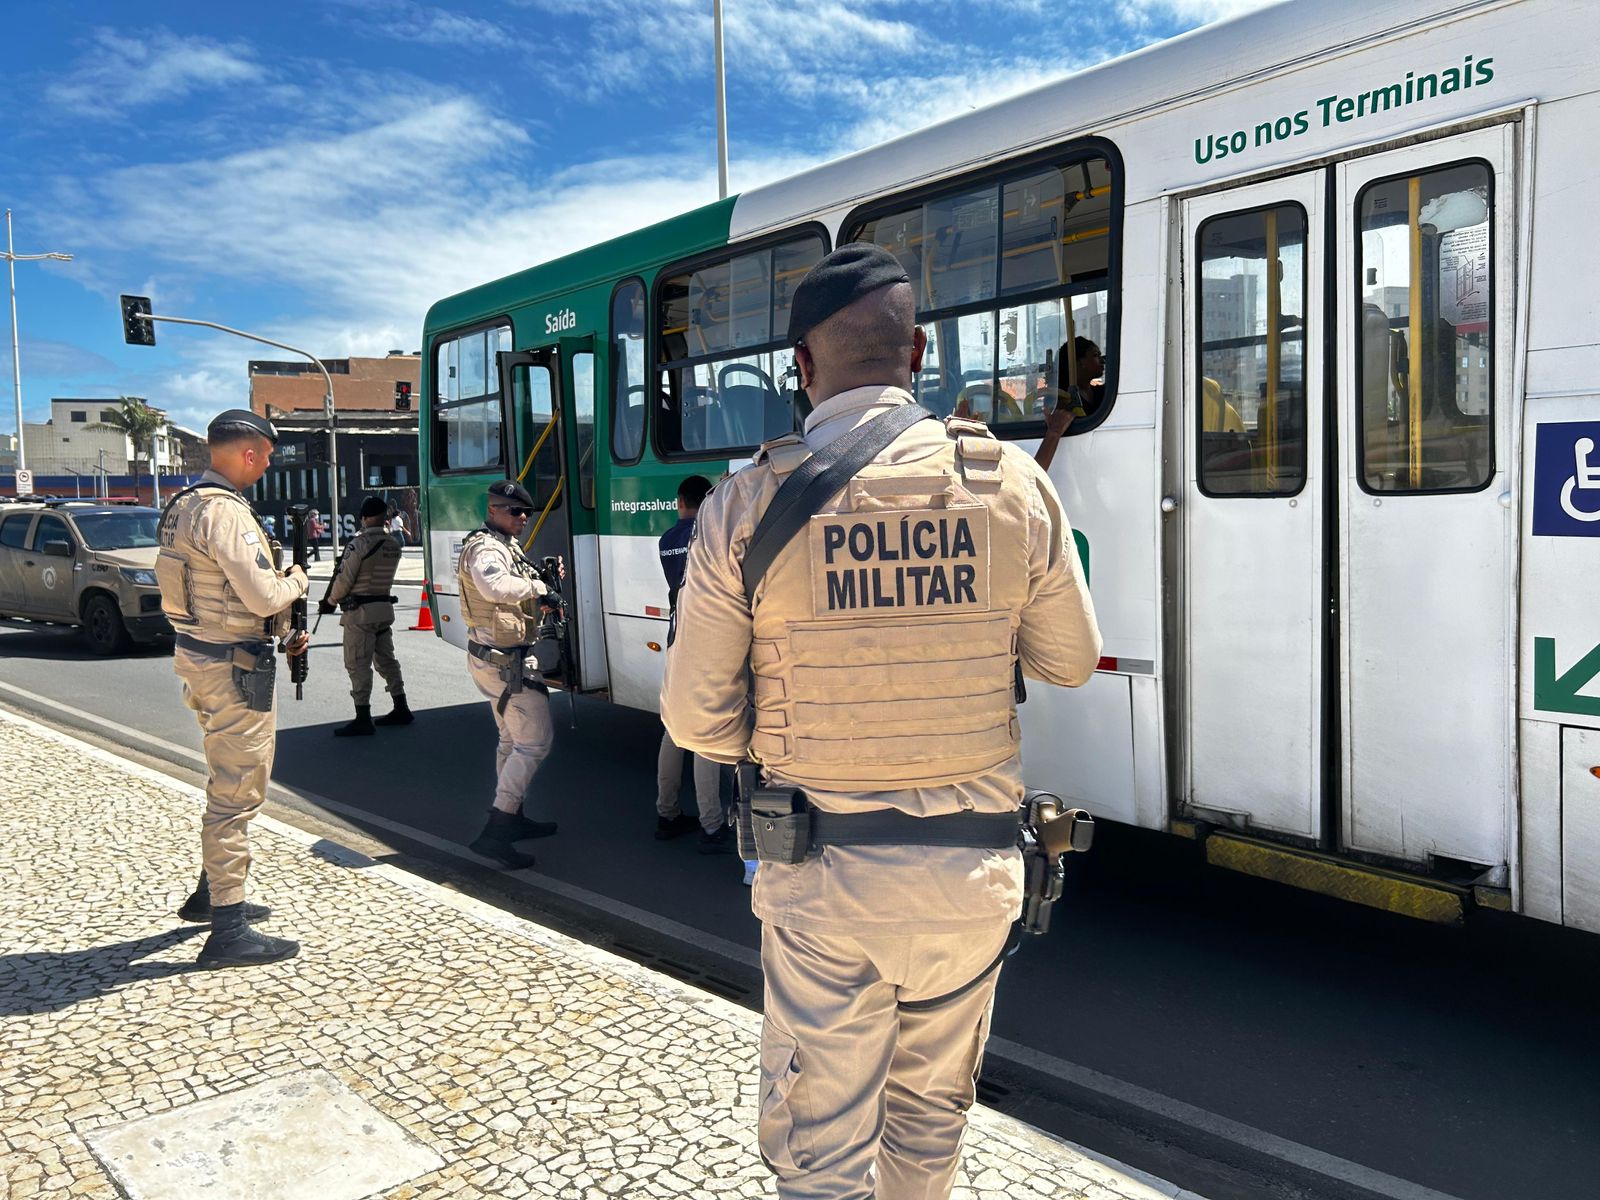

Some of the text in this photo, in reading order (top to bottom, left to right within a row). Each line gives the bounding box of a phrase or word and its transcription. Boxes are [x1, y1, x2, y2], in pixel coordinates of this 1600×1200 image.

[1194, 54, 1495, 165] Uso nos Terminais
[545, 308, 576, 335] Saída
[611, 498, 679, 514] integrasalvad
[823, 514, 977, 564] POLÍCIA
[825, 563, 977, 610] MILITAR
